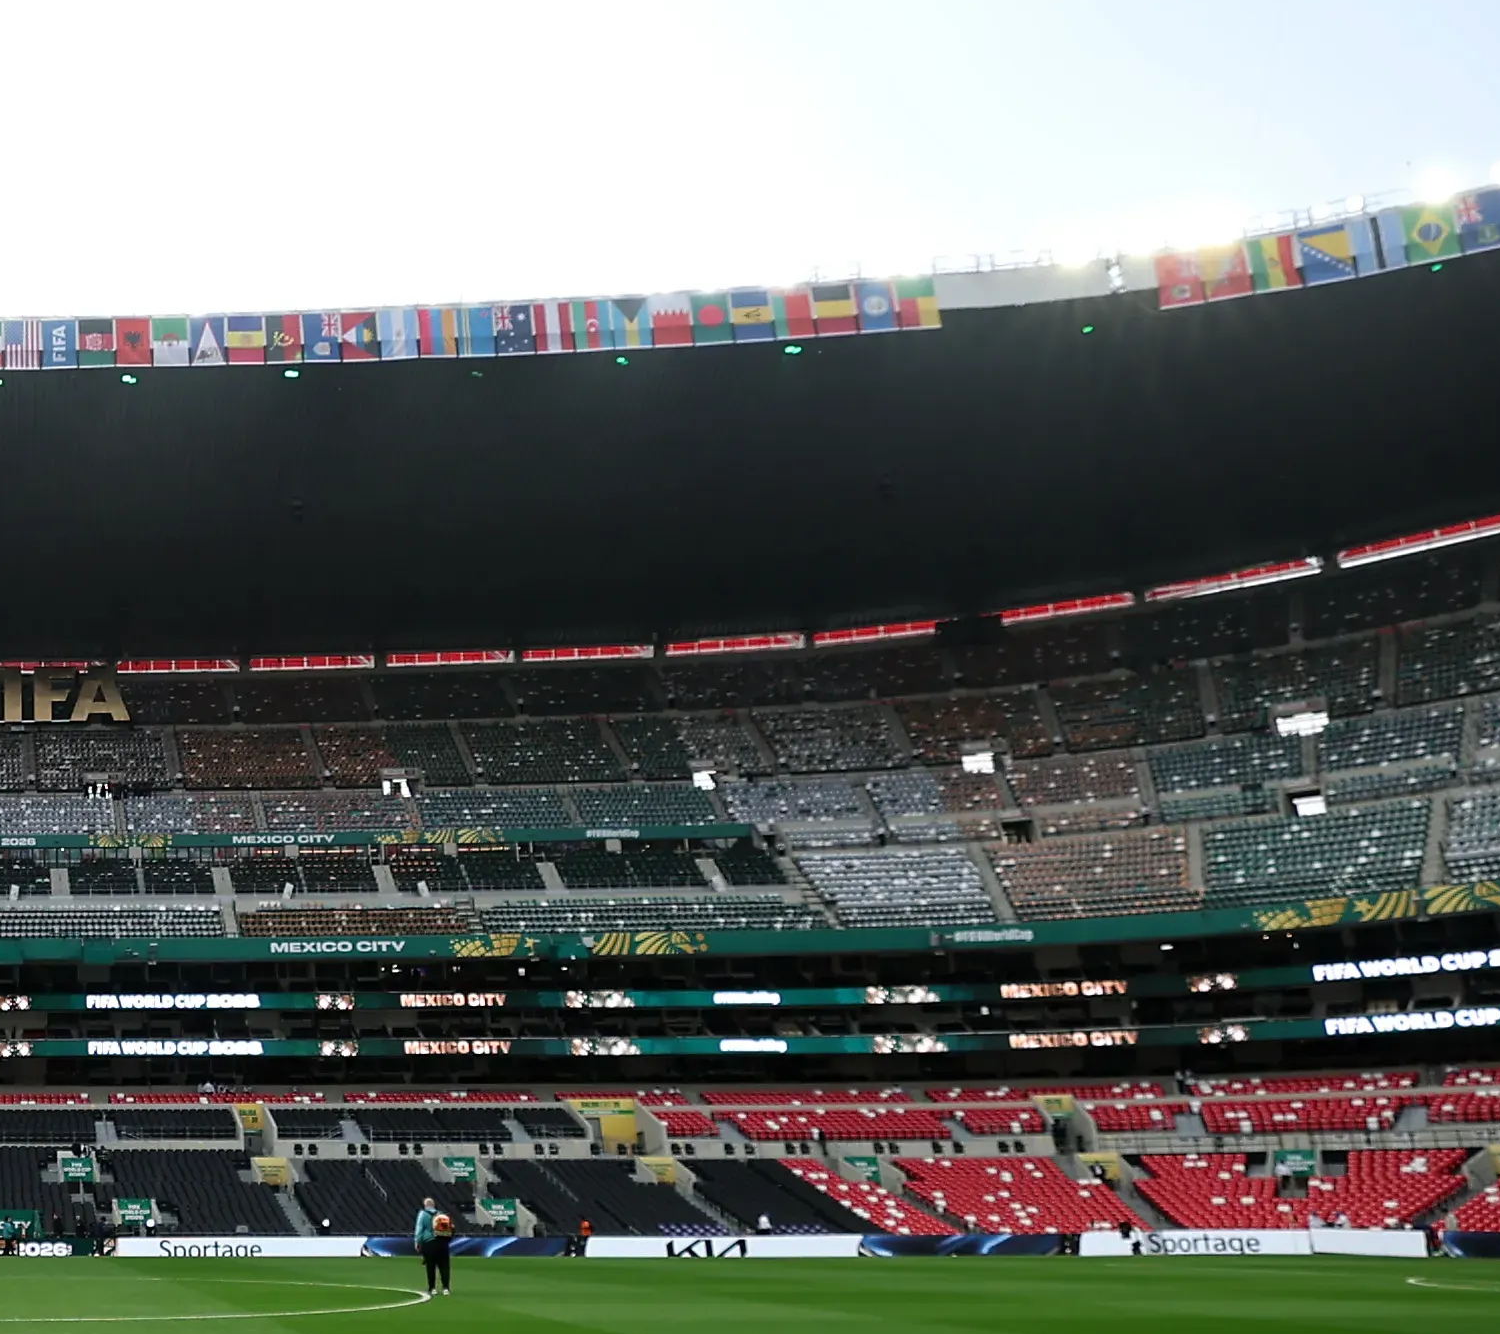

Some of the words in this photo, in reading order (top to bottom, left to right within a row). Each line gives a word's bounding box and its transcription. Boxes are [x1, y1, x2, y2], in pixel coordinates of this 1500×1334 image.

[52, 325, 66, 362] FIFA
[1, 837, 36, 847] 2026
[232, 835, 294, 845] MEXICO
[298, 834, 335, 844] CITY
[270, 942, 351, 954] MEXICO
[356, 941, 406, 953] CITY
[1312, 963, 1361, 981] FIFA
[1359, 956, 1440, 978] WORLD
[1440, 951, 1487, 971] CUP
[1000, 982, 1078, 998] MEXICO
[1081, 980, 1127, 996] CITY
[86, 995, 119, 1008] FIFA
[119, 995, 174, 1008] WORLD
[174, 995, 206, 1008] CUP
[400, 993, 466, 1007] MEXICO
[468, 993, 507, 1007] CITY
[1324, 1017, 1374, 1035] FIFA
[1372, 1011, 1454, 1032] WORLD
[88, 1041, 121, 1055] FIFA
[121, 1041, 176, 1055] WORLD
[177, 1041, 208, 1055] CUP
[404, 1040, 471, 1055] MEXICO
[472, 1040, 511, 1055] CITY
[1009, 1033, 1087, 1049] MEXICO
[1090, 1031, 1138, 1047] CITY
[159, 1240, 262, 1257] Sportage
[666, 1239, 747, 1258] KIA
[1149, 1233, 1260, 1253] Sportage
